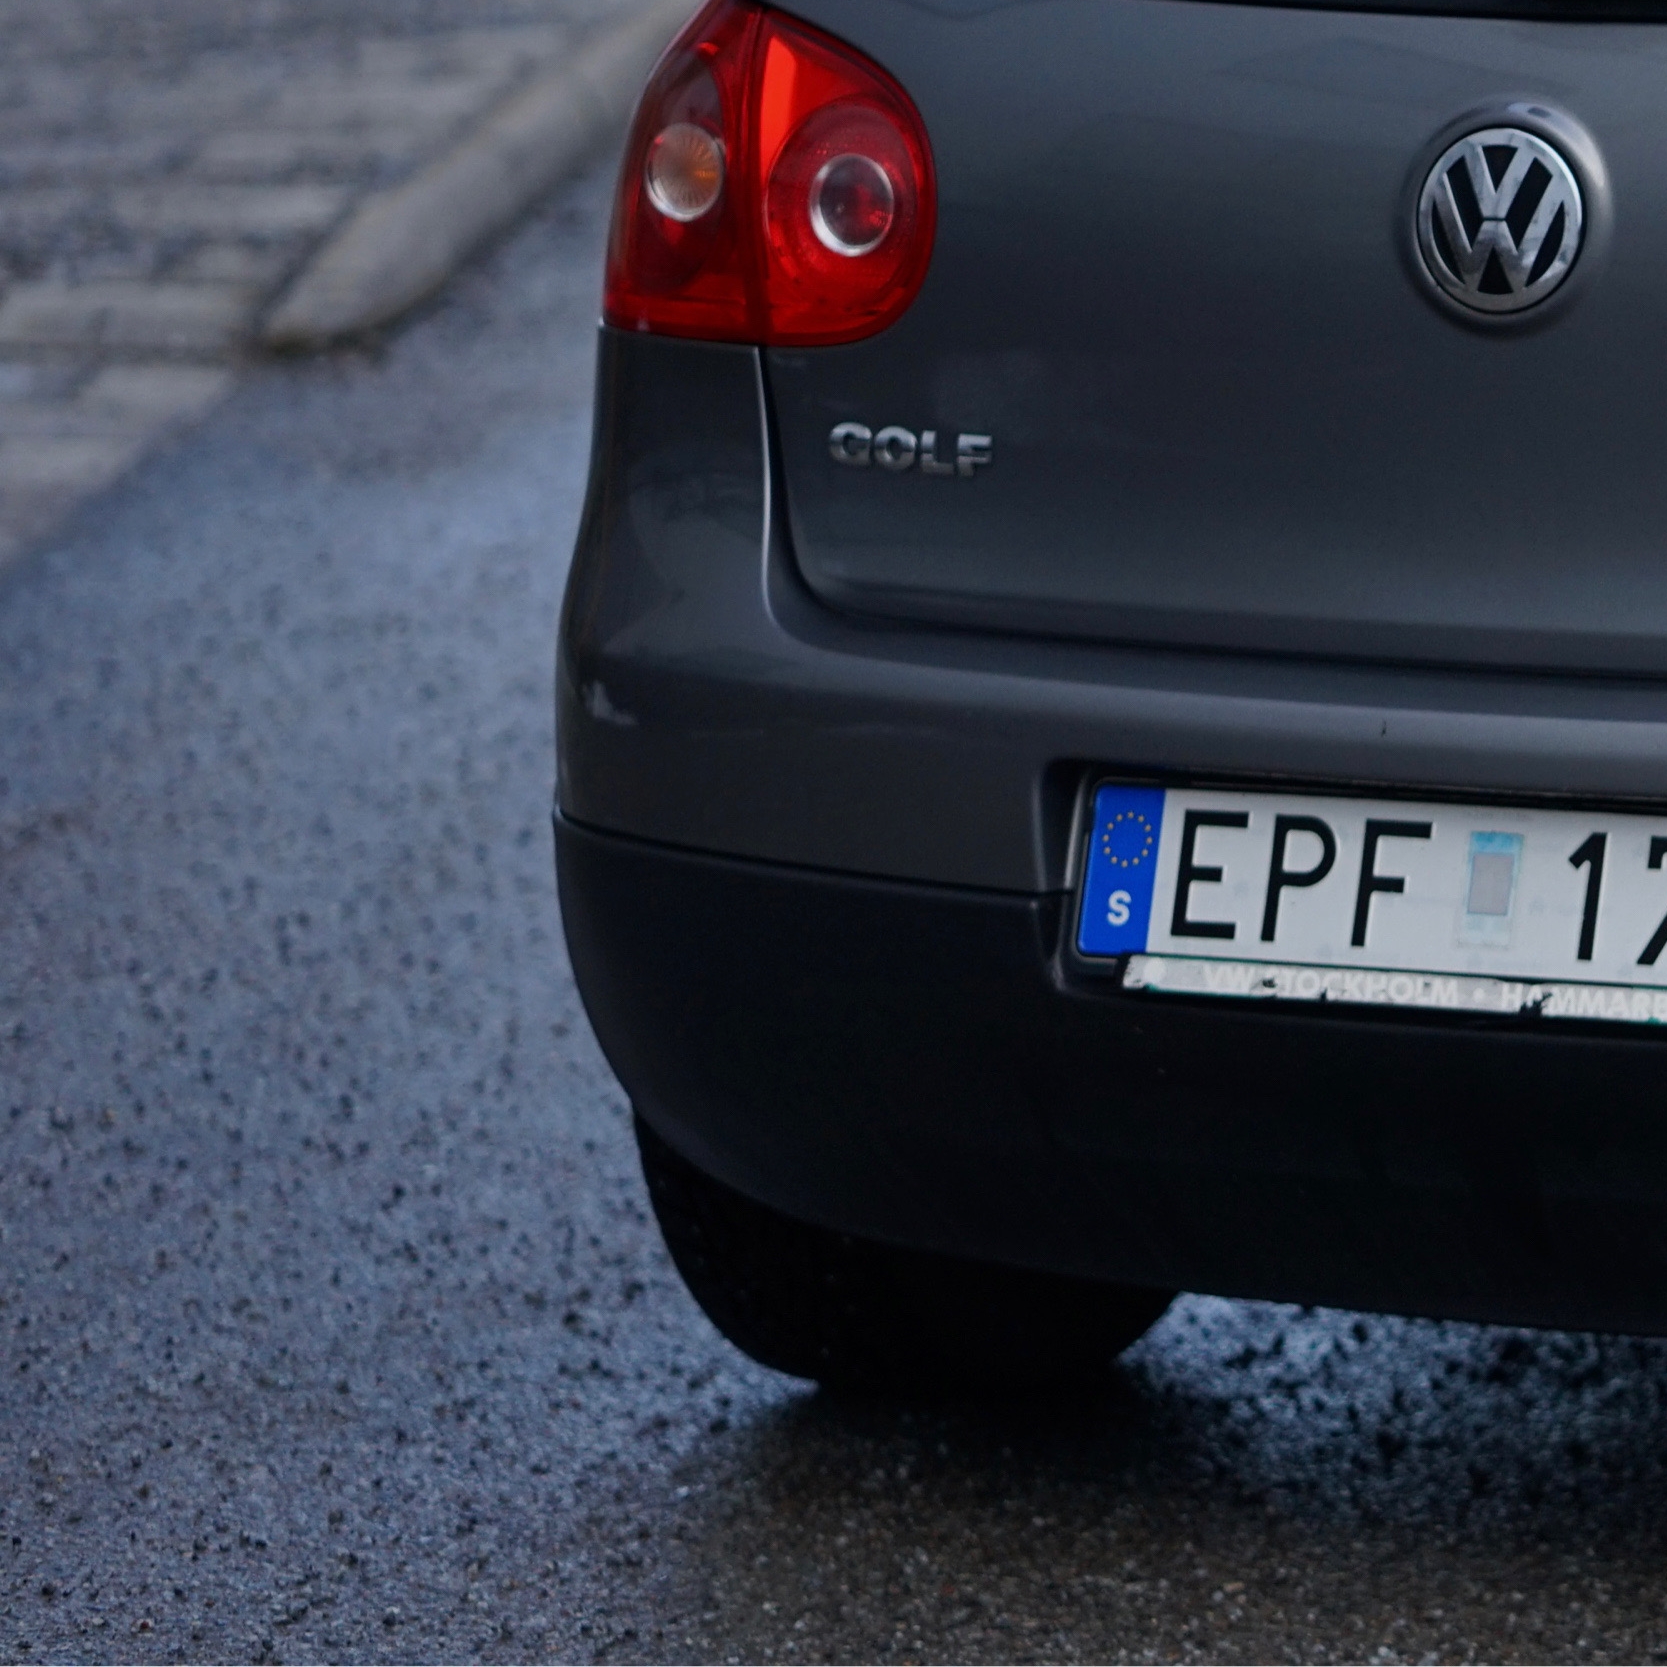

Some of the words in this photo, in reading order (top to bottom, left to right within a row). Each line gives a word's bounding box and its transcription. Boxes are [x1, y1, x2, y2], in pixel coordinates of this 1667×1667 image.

[1418, 128, 1583, 311] VW
[829, 421, 993, 478] GOLF
[1170, 808, 1433, 947] EPF
[1107, 889, 1132, 927] S
[1202, 963, 1257, 994] VW
